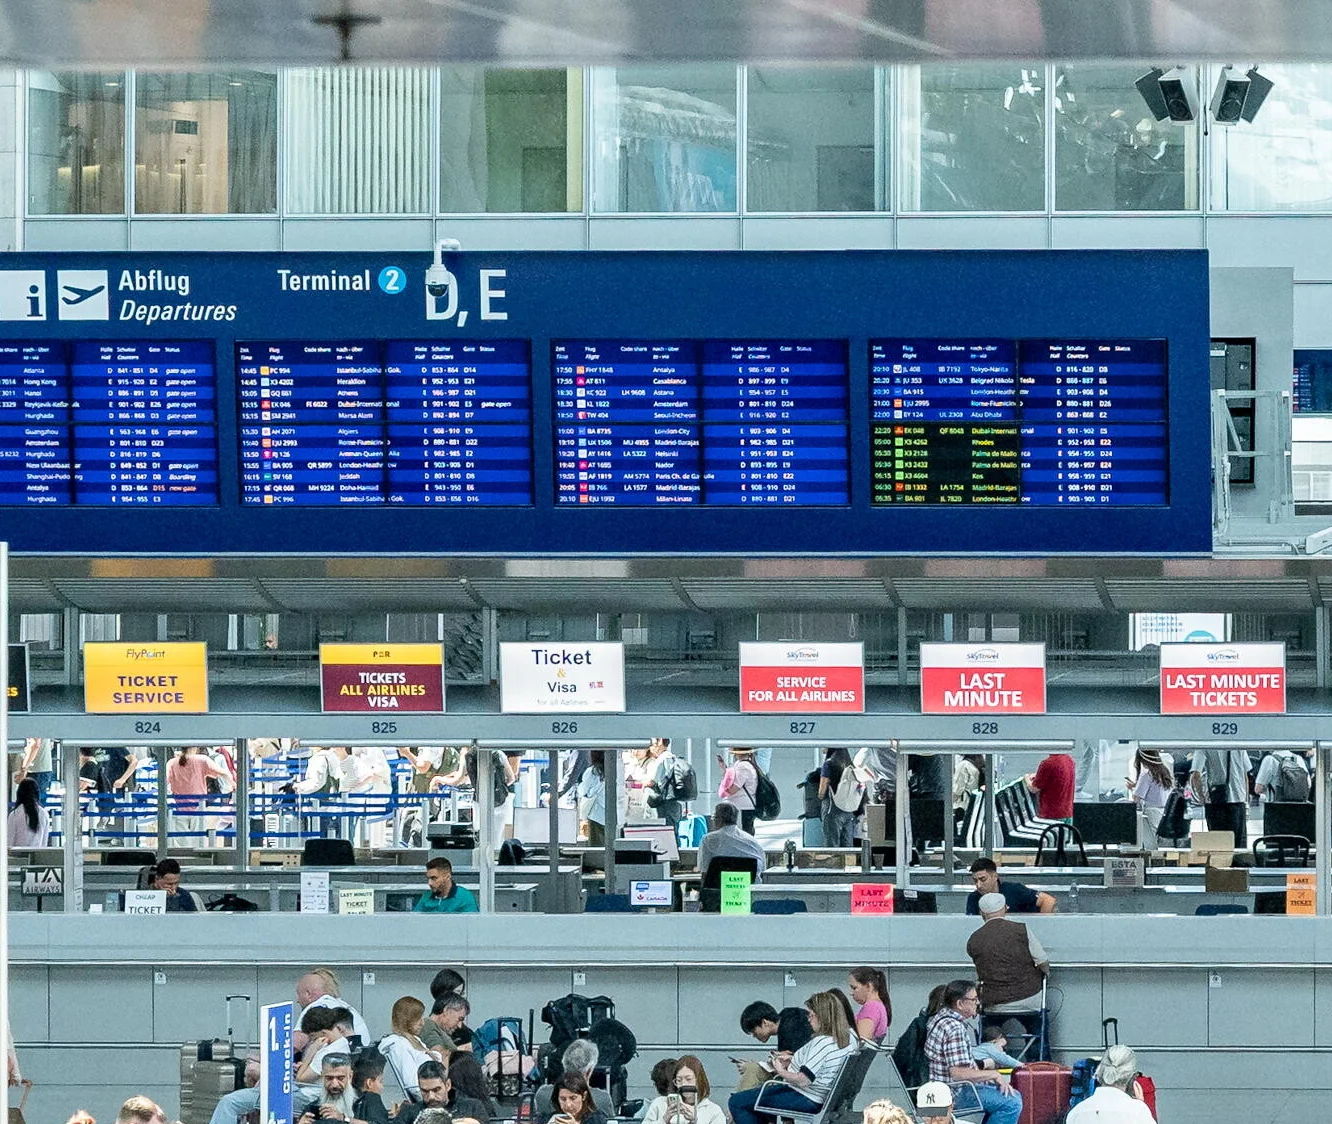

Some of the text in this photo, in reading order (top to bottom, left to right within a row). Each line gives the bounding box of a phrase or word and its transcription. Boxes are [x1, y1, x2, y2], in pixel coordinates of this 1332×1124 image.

[118, 270, 190, 297] Abflug
[277, 270, 400, 292] Terminal 2
[479, 270, 509, 321] E
[118, 299, 238, 325] Departures
[531, 648, 593, 666] Ticket
[358, 672, 407, 685] TICKETS
[557, 668, 567, 678] &
[118, 675, 178, 688] TICKET
[547, 681, 578, 694] Visa
[776, 676, 827, 689] SERVICE
[959, 673, 1005, 690] LAST
[1166, 674, 1280, 690] LAST MINUTE
[339, 684, 426, 697] ALL AIRLINES
[748, 690, 856, 703] FOR ALL AIRLINES
[112, 692, 185, 705] SERVICE
[367, 696, 399, 709] VISA
[944, 691, 1023, 708] MINUTE
[1189, 692, 1258, 707] TICKETS
[135, 722, 162, 734] 824
[372, 722, 398, 734] 825
[552, 722, 578, 734] 826
[790, 722, 816, 734] 827
[972, 722, 999, 735] 828
[1212, 722, 1238, 735] 829
[1111, 861, 1137, 869] ESTA
[860, 889, 884, 897] LAST
[269, 1016, 279, 1052] 1.
[283, 1013, 292, 1094] Check-in
